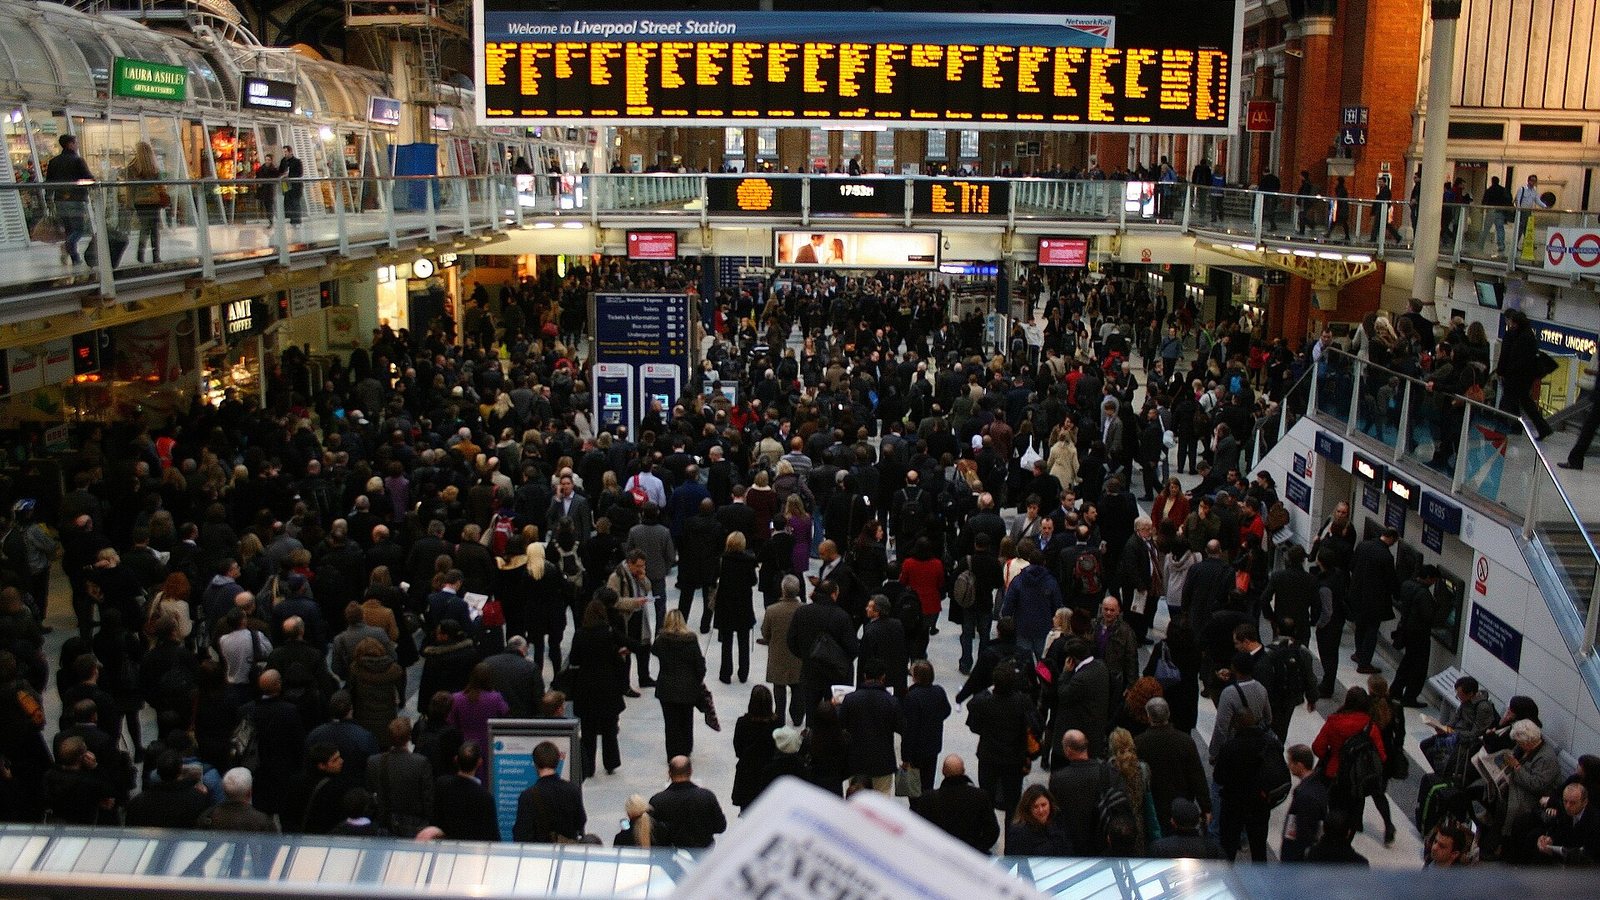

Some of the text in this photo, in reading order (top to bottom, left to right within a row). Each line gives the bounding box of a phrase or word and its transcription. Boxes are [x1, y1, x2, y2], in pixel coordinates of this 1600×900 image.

[508, 20, 736, 38] Welcome to Liverpool Street Station
[124, 67, 186, 85] LAURA ASHLEY
[225, 299, 253, 321] AMT
[229, 318, 253, 334] COFFEE
[1540, 329, 1563, 346] STREET
[498, 758, 530, 766] Welcome
